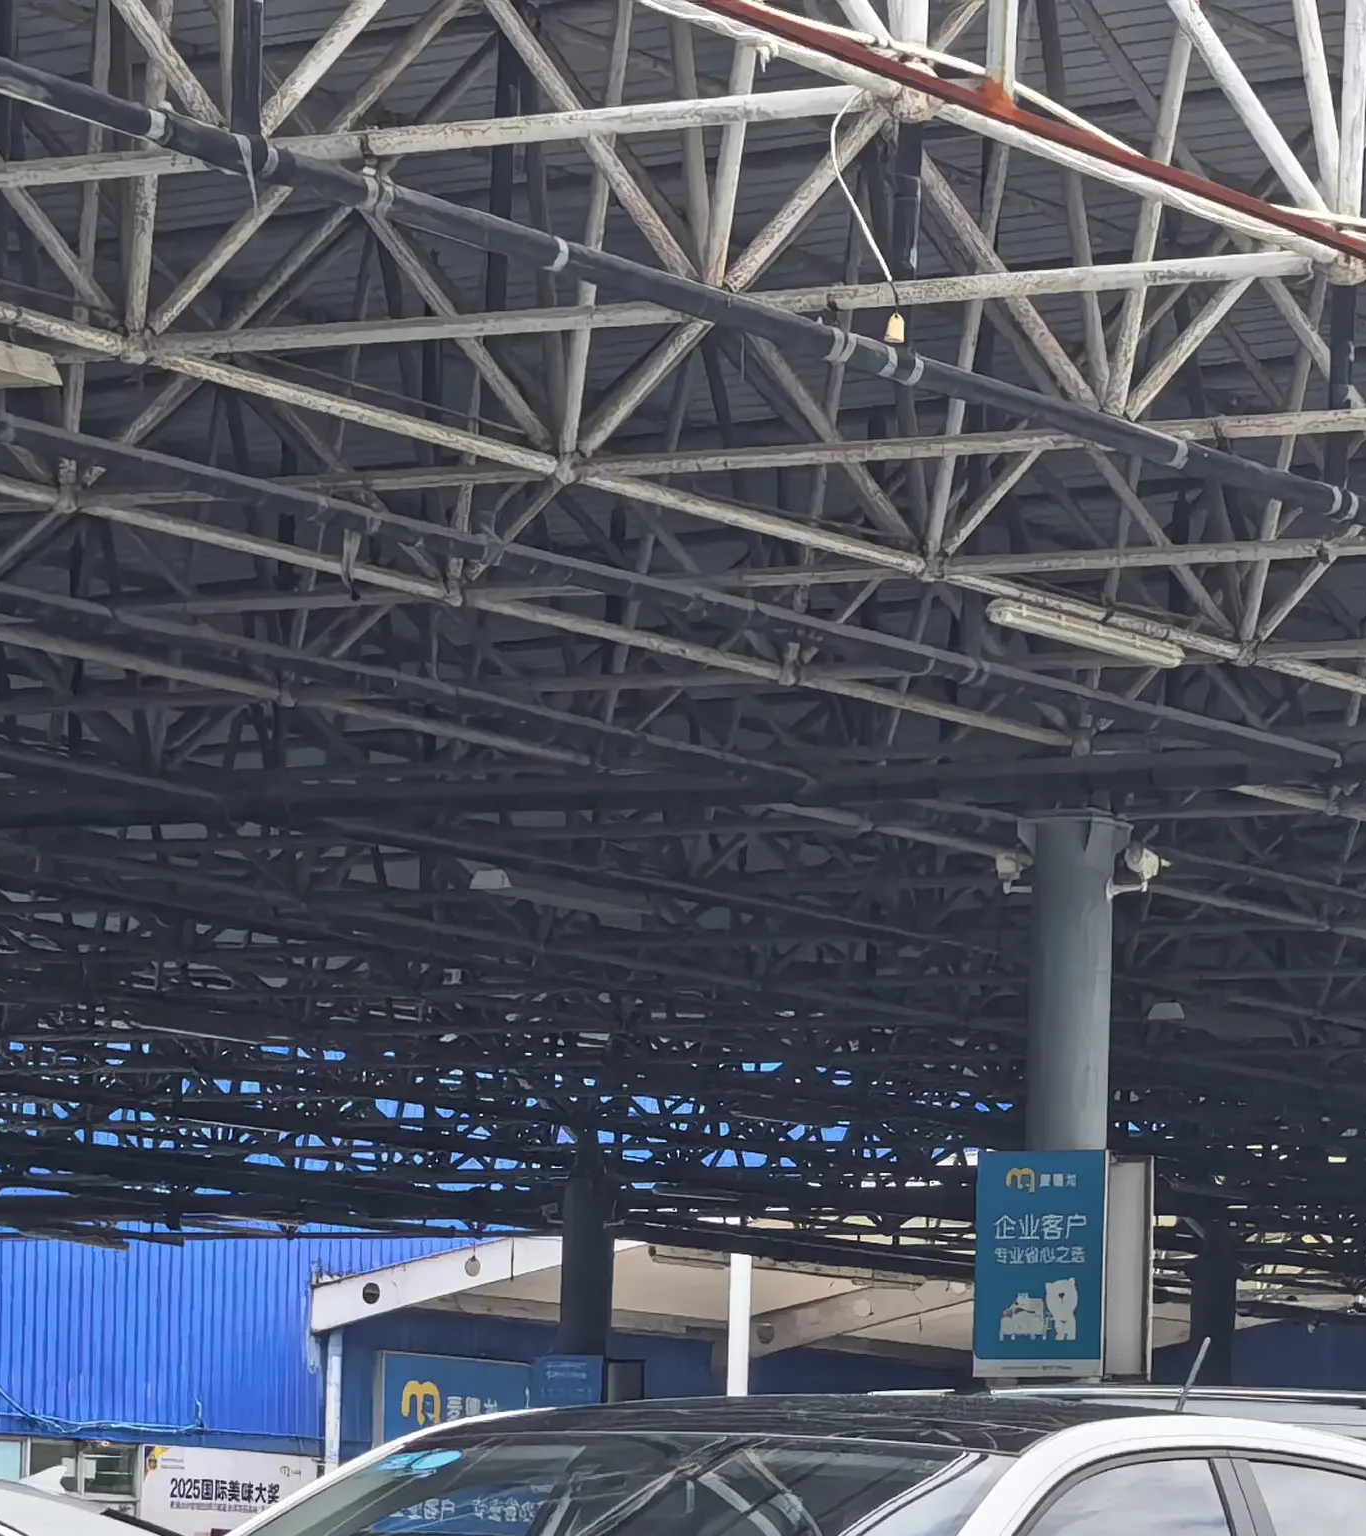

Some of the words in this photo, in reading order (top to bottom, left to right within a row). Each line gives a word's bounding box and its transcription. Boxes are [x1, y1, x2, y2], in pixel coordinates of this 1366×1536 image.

[994, 1213, 1087, 1241] 企业客户
[169, 1477, 280, 1505] 2025国际美味大奖
